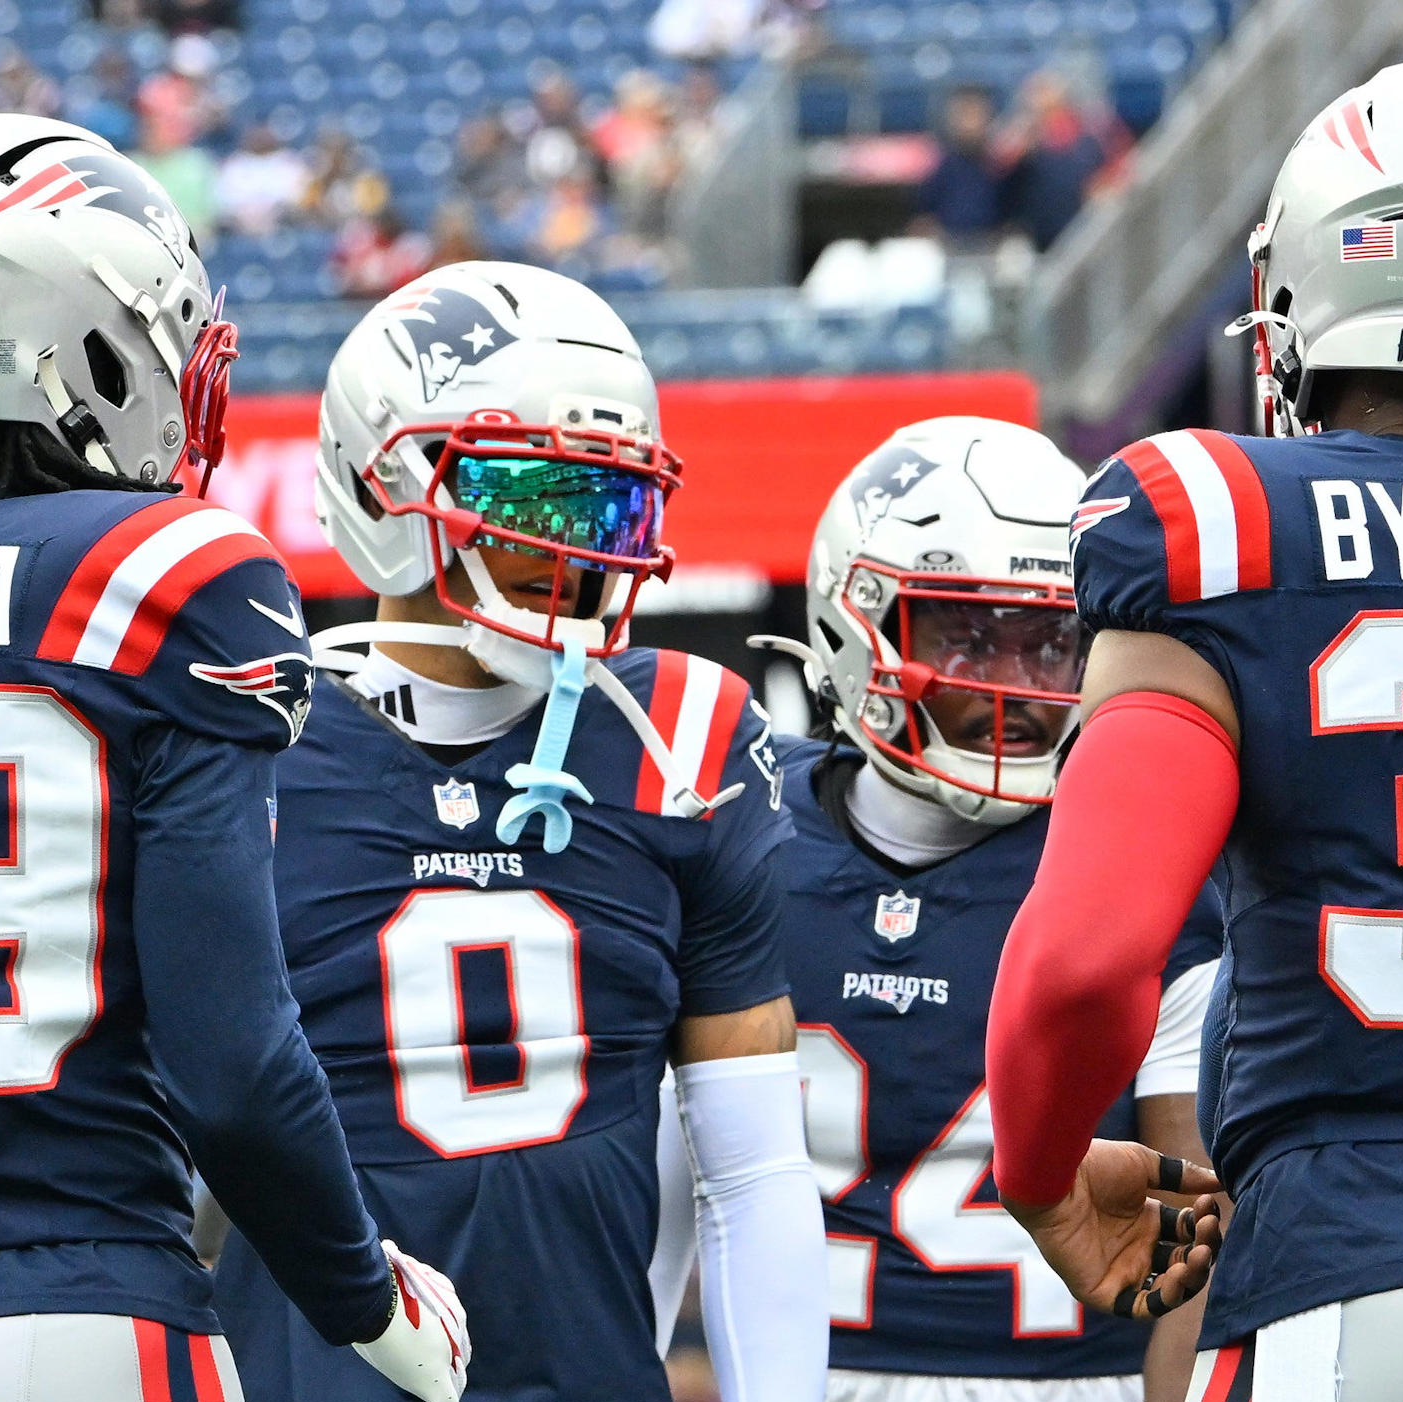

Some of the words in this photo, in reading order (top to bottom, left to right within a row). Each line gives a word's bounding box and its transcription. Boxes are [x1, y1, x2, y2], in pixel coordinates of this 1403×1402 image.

[1010, 556, 1072, 577] PATRIOT
[445, 801, 473, 819] NFL
[413, 852, 524, 880] PATRIOTS
[883, 912, 909, 932] NFL
[842, 972, 949, 1005] PATRIOTS
[377, 887, 591, 1160] 0
